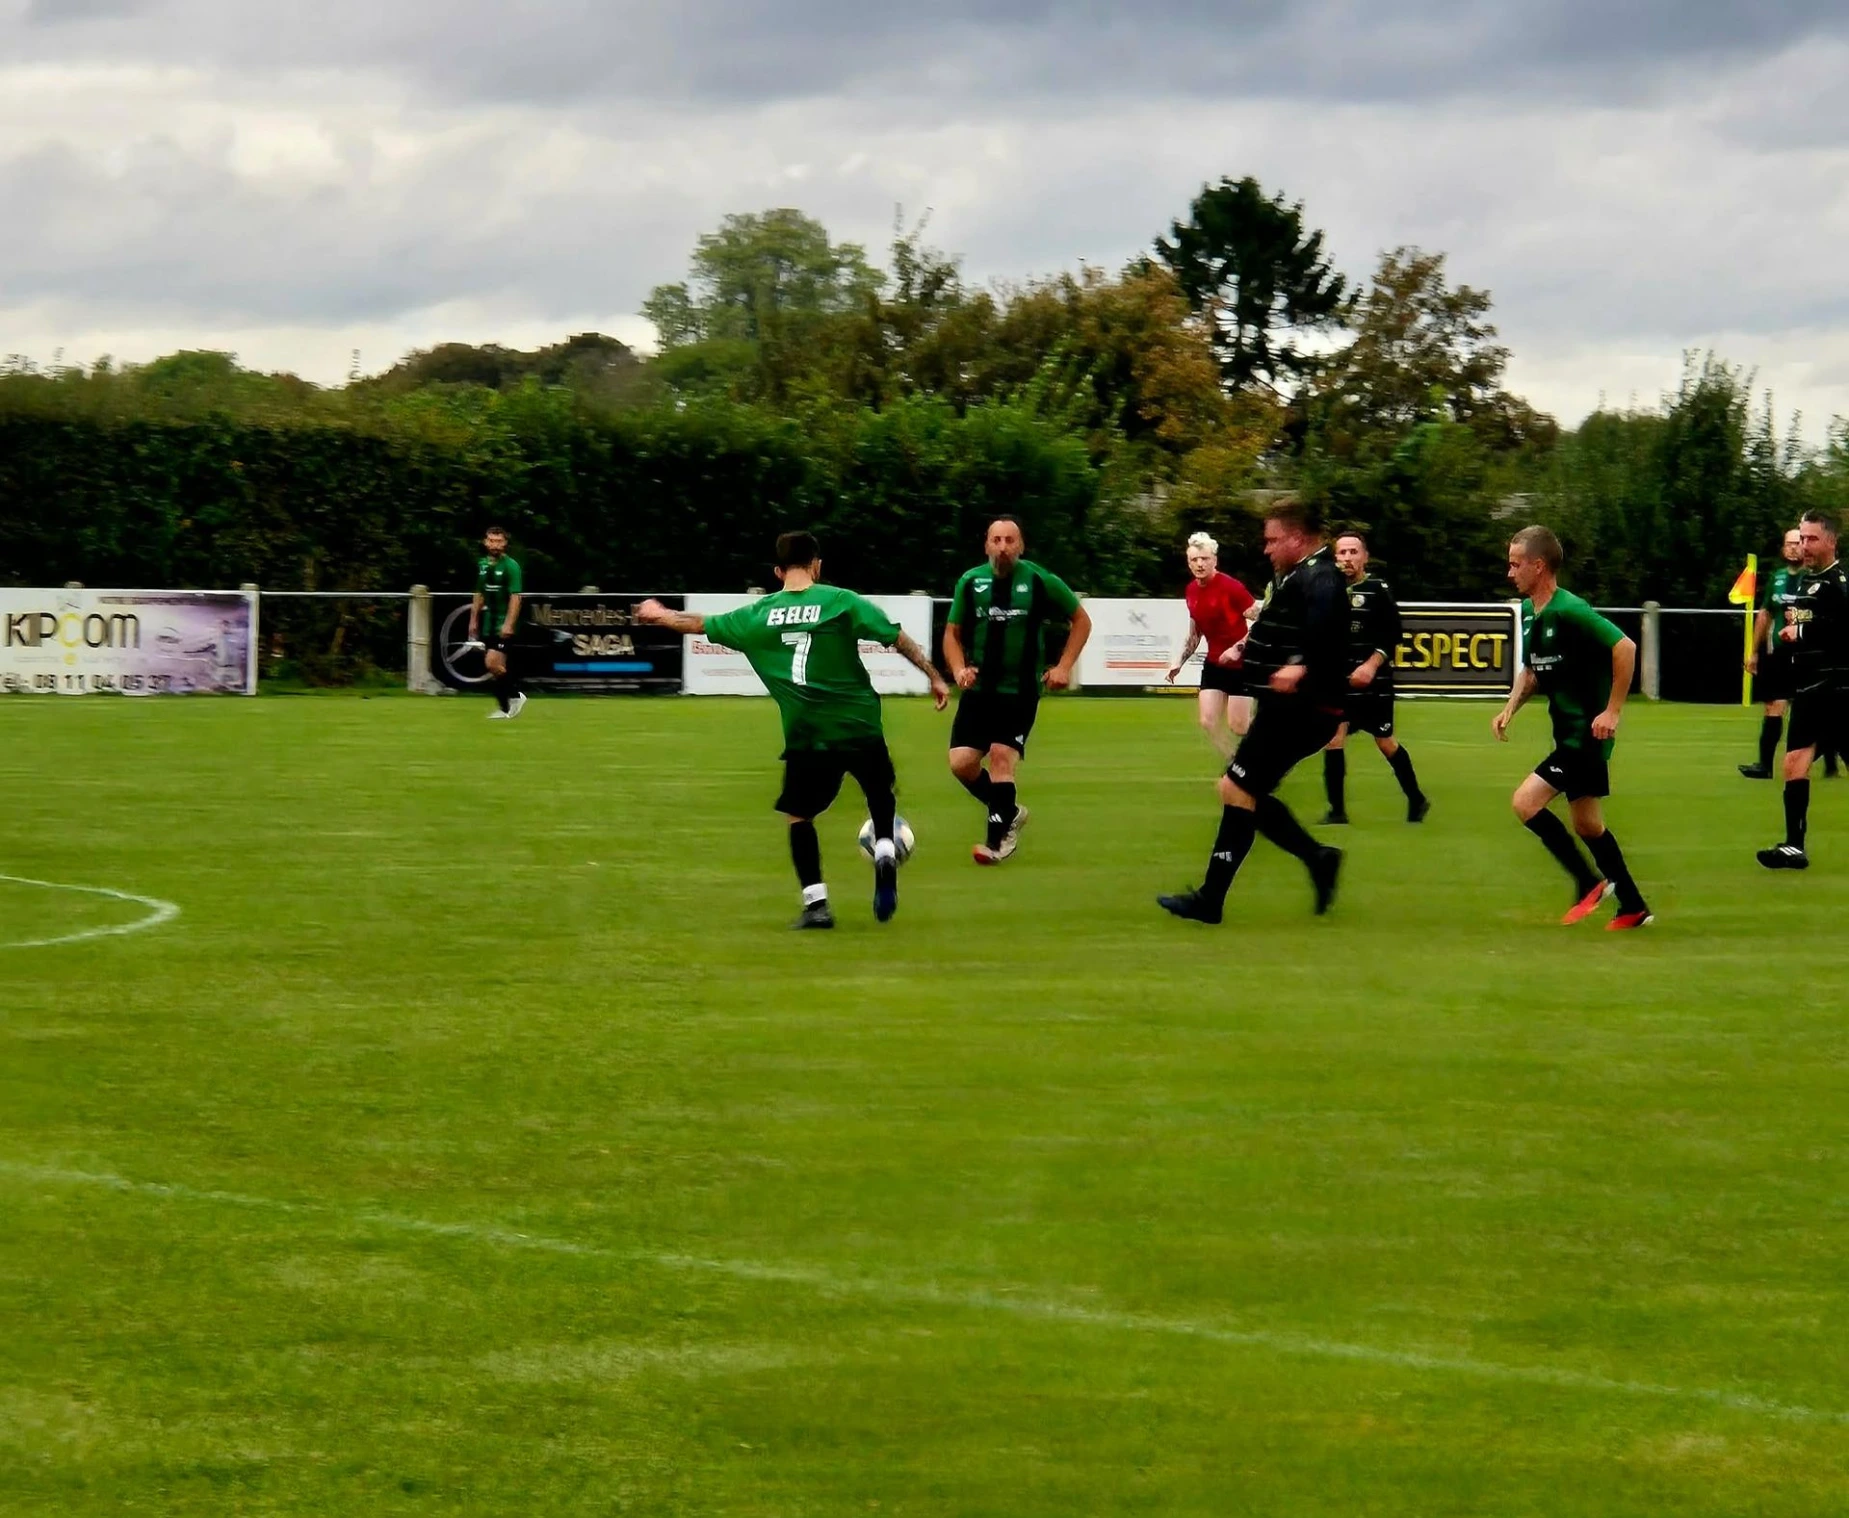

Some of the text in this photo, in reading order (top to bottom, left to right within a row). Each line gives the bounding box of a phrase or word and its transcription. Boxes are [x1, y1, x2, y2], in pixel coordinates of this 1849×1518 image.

[571, 634, 636, 656] SAGA
[781, 631, 812, 685] 7
[1389, 632, 1509, 667] ESPECT
